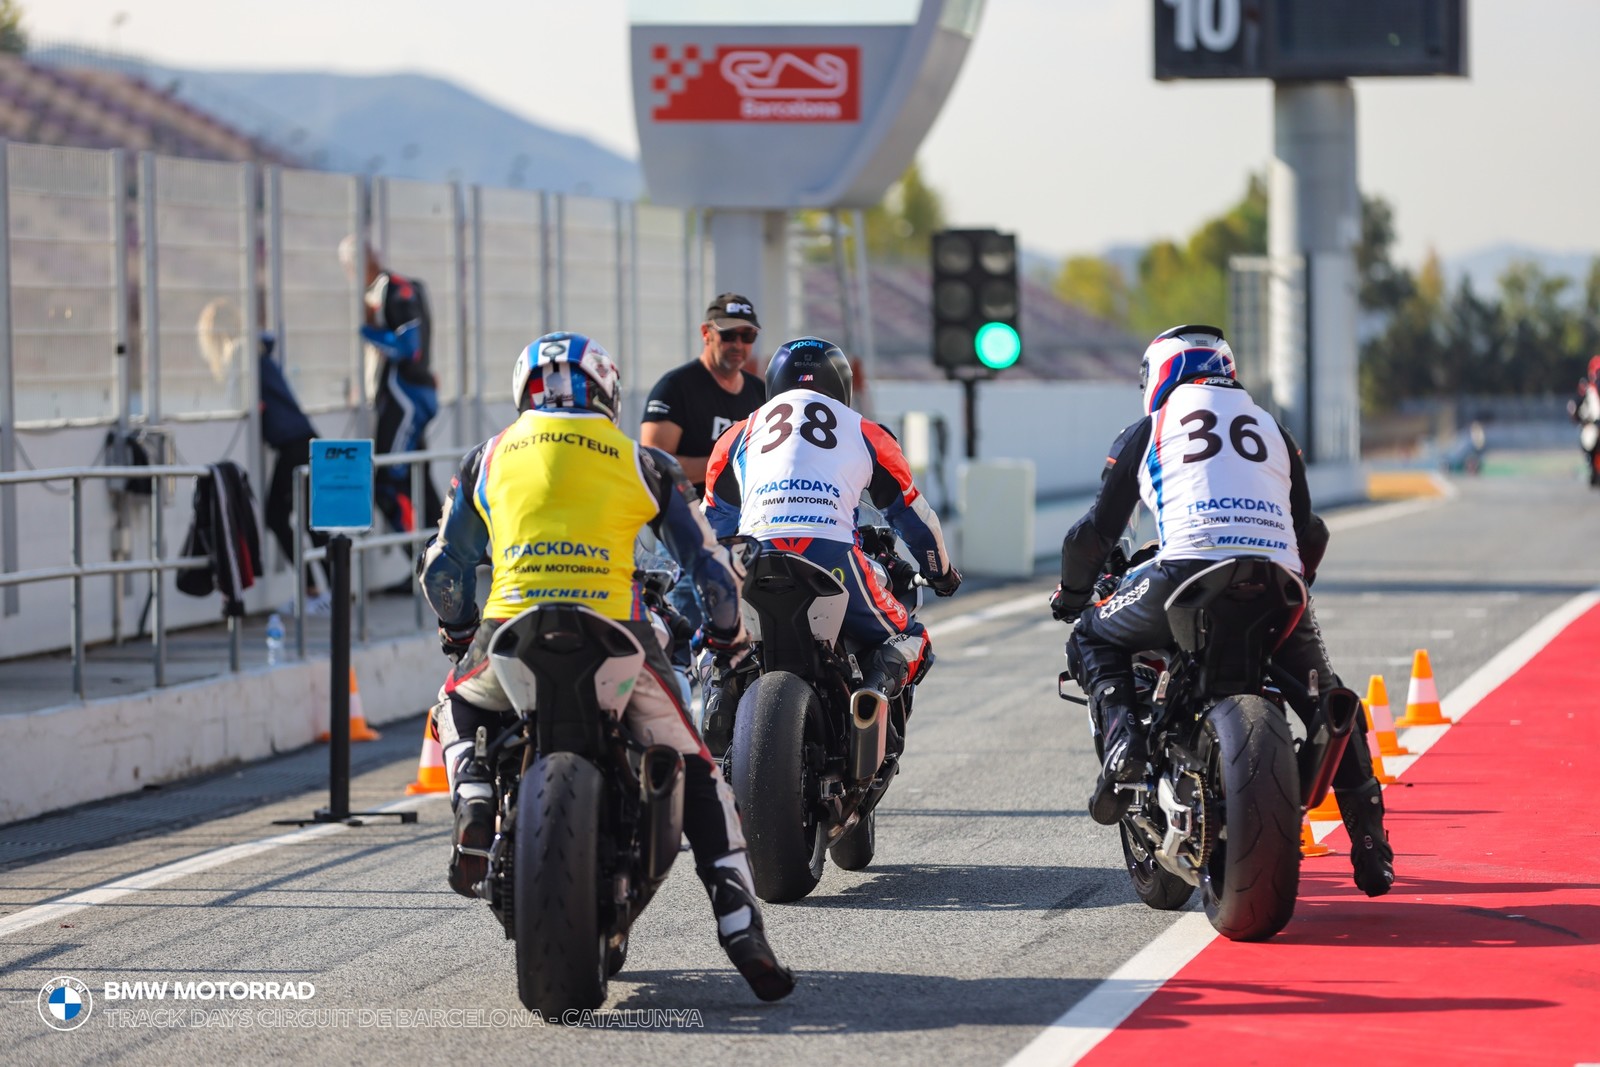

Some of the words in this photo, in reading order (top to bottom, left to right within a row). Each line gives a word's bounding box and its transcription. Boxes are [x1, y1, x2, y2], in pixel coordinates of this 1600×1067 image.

[1163, 0, 1241, 51] 10
[742, 98, 841, 118] Barcelona
[761, 401, 838, 454] 38
[1179, 409, 1269, 464] 36
[504, 432, 620, 460] INSTRUCTEUR
[755, 478, 841, 498] TRACKDAYS
[762, 497, 786, 506] BMW
[1186, 497, 1283, 517] TRACKDAYS
[771, 515, 838, 526] MICHELIN
[1203, 516, 1231, 525] BMW
[1234, 515, 1285, 530] MOTORRAD
[504, 541, 610, 561] TRACKDAYS
[1217, 536, 1288, 550] MICHELIN
[514, 564, 542, 574] BMW
[545, 564, 610, 575] MOTORRAD
[525, 588, 610, 599] MICHELIN
